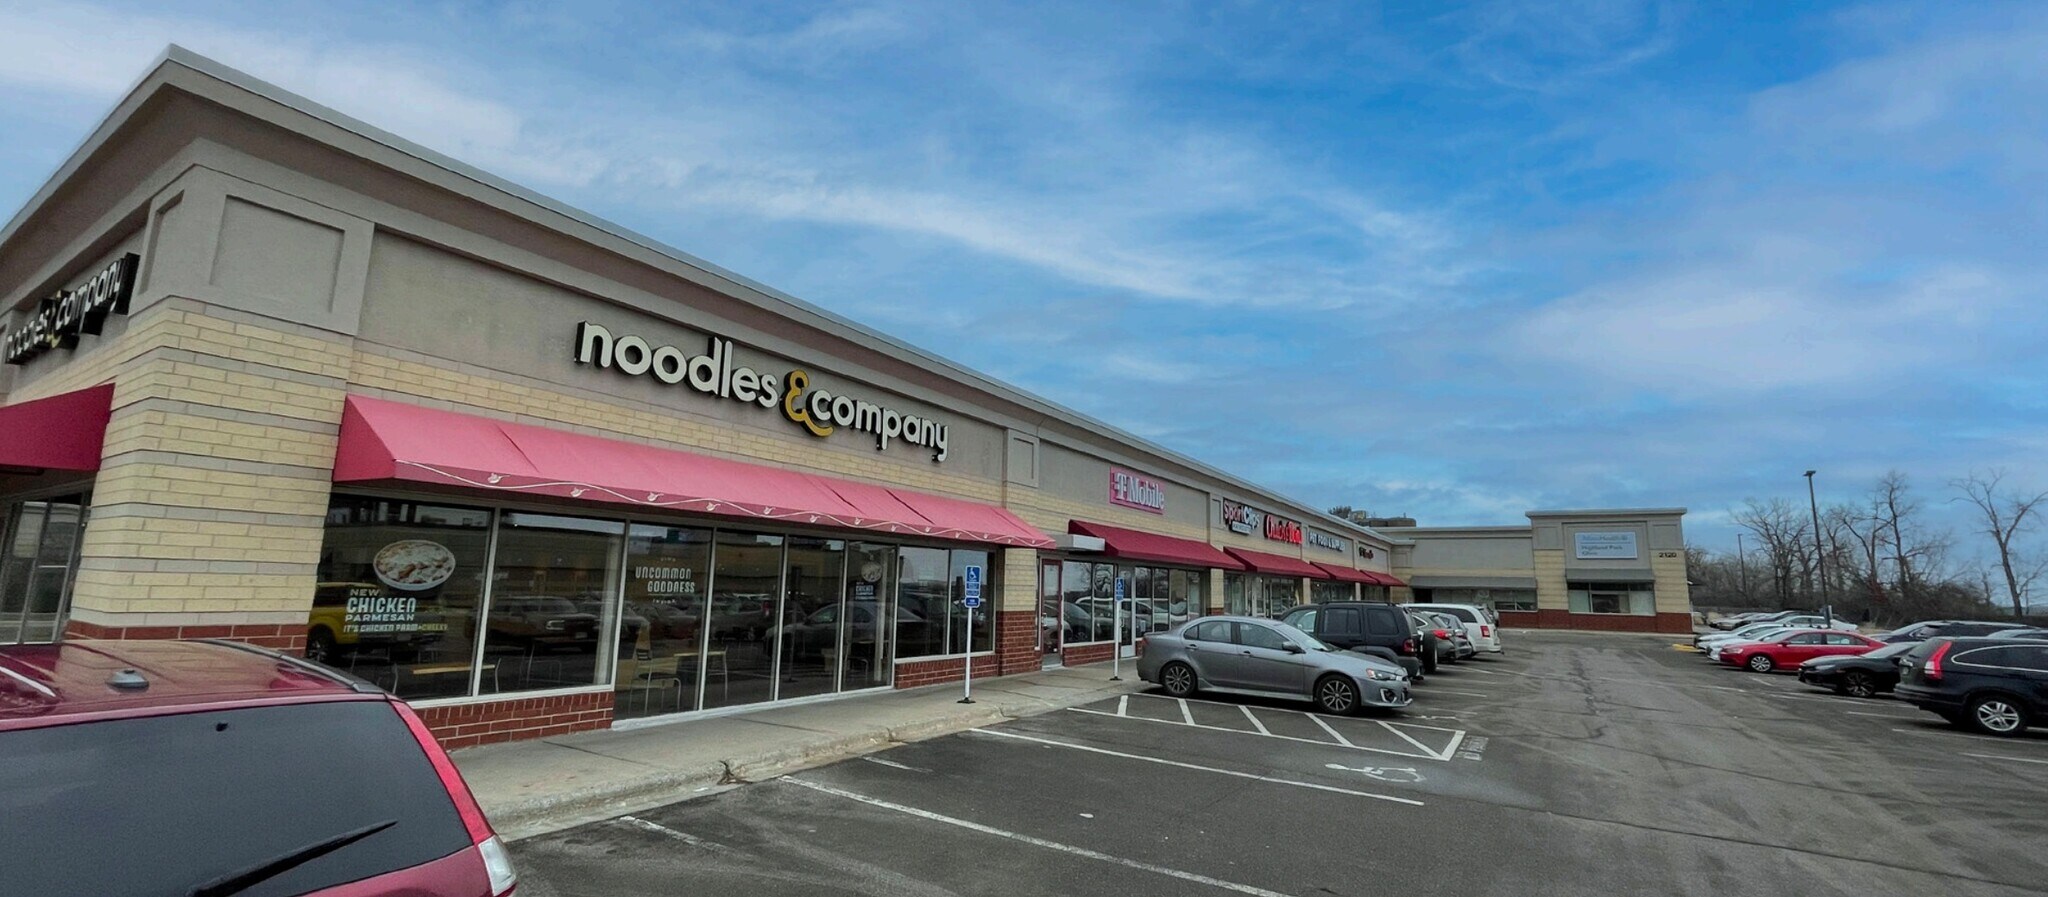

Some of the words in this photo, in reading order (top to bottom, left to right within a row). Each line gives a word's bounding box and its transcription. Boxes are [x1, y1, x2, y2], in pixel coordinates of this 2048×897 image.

[55, 259, 125, 333] company
[575, 322, 778, 409] noodles
[782, 369, 834, 437] &
[810, 389, 949, 462] company
[635, 566, 692, 580] UNCOMMON
[350, 588, 381, 597] NEW
[647, 581, 696, 593] GOODNESS
[346, 597, 417, 613] CHICKEN
[344, 613, 415, 622] PARMESAN
[359, 624, 394, 632] CHICKEN
